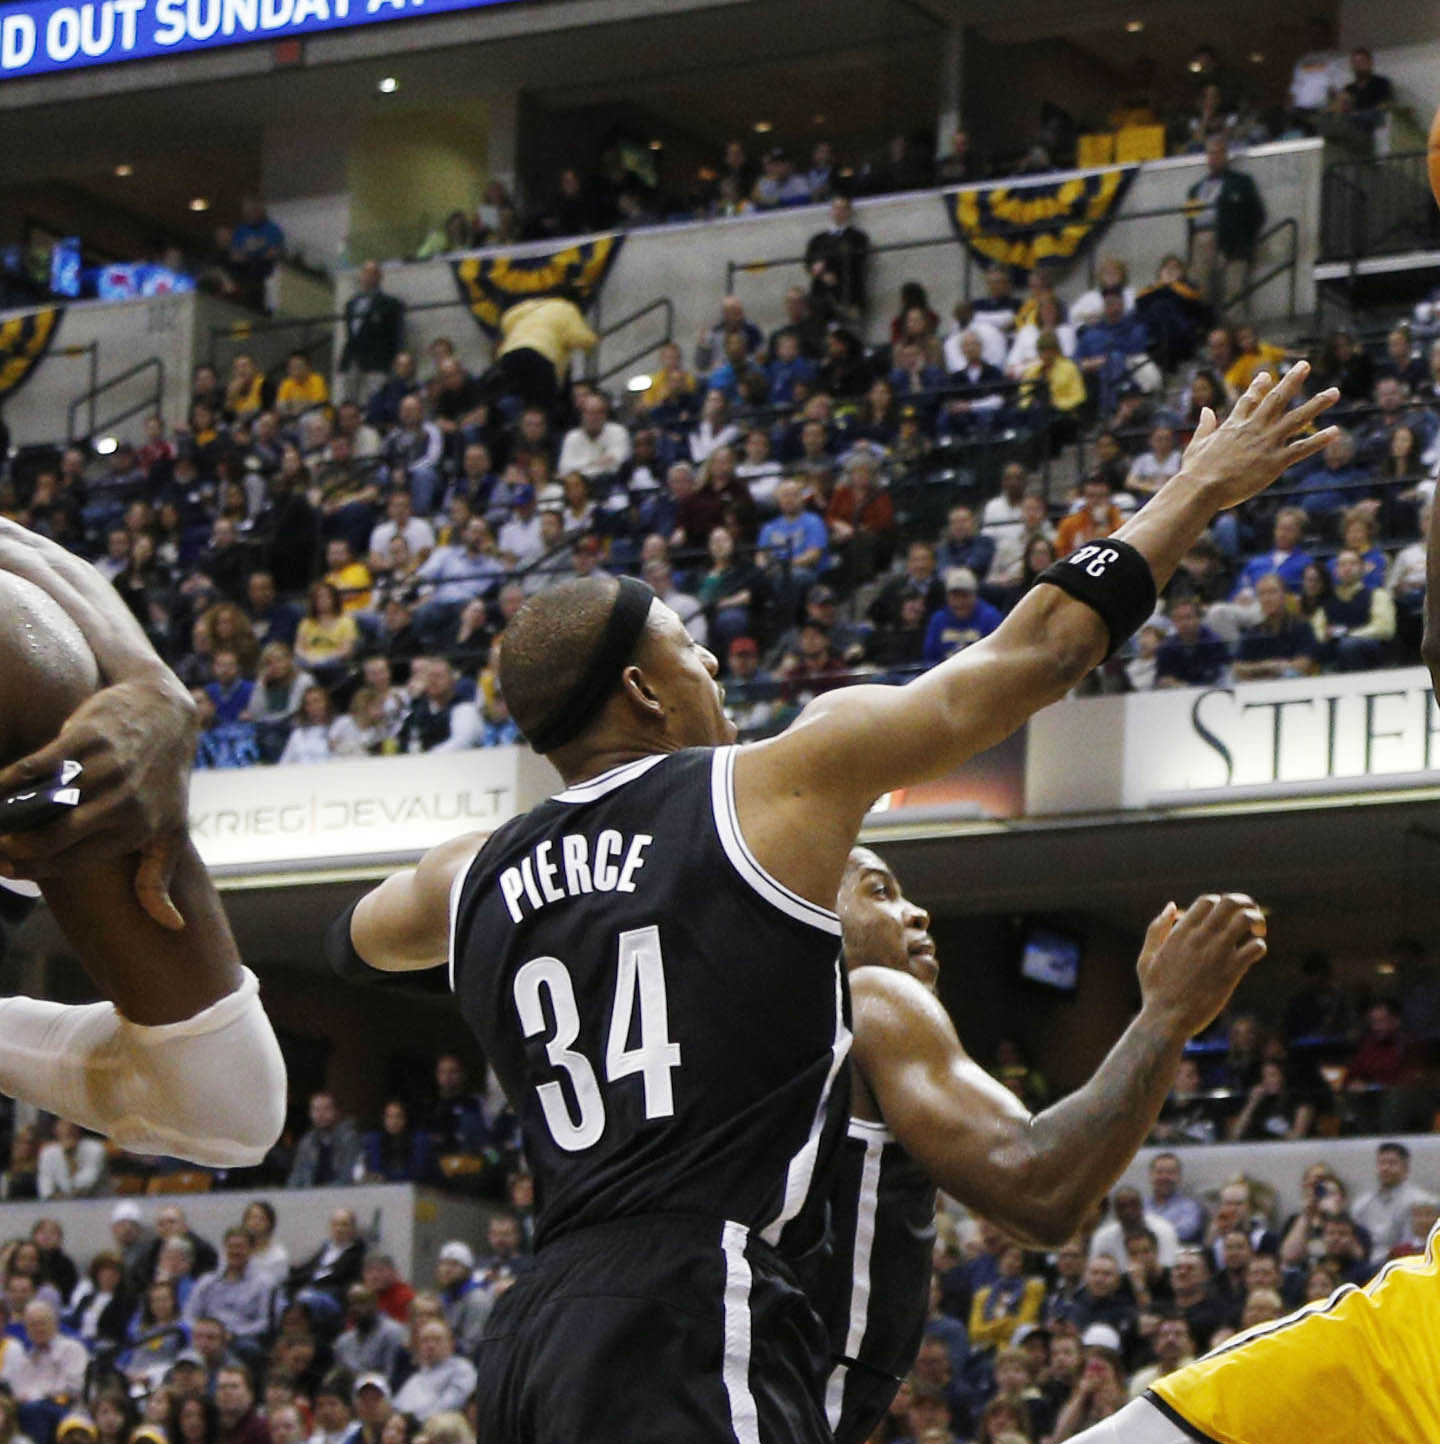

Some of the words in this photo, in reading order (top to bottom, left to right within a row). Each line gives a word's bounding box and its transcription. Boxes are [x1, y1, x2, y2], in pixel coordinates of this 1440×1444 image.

[45, 0, 144, 61] OUT
[190, 802, 306, 840] KRIEG
[322, 787, 509, 831] DEVAULT
[498, 829, 654, 925] PIERCE
[513, 924, 682, 1152] 34
